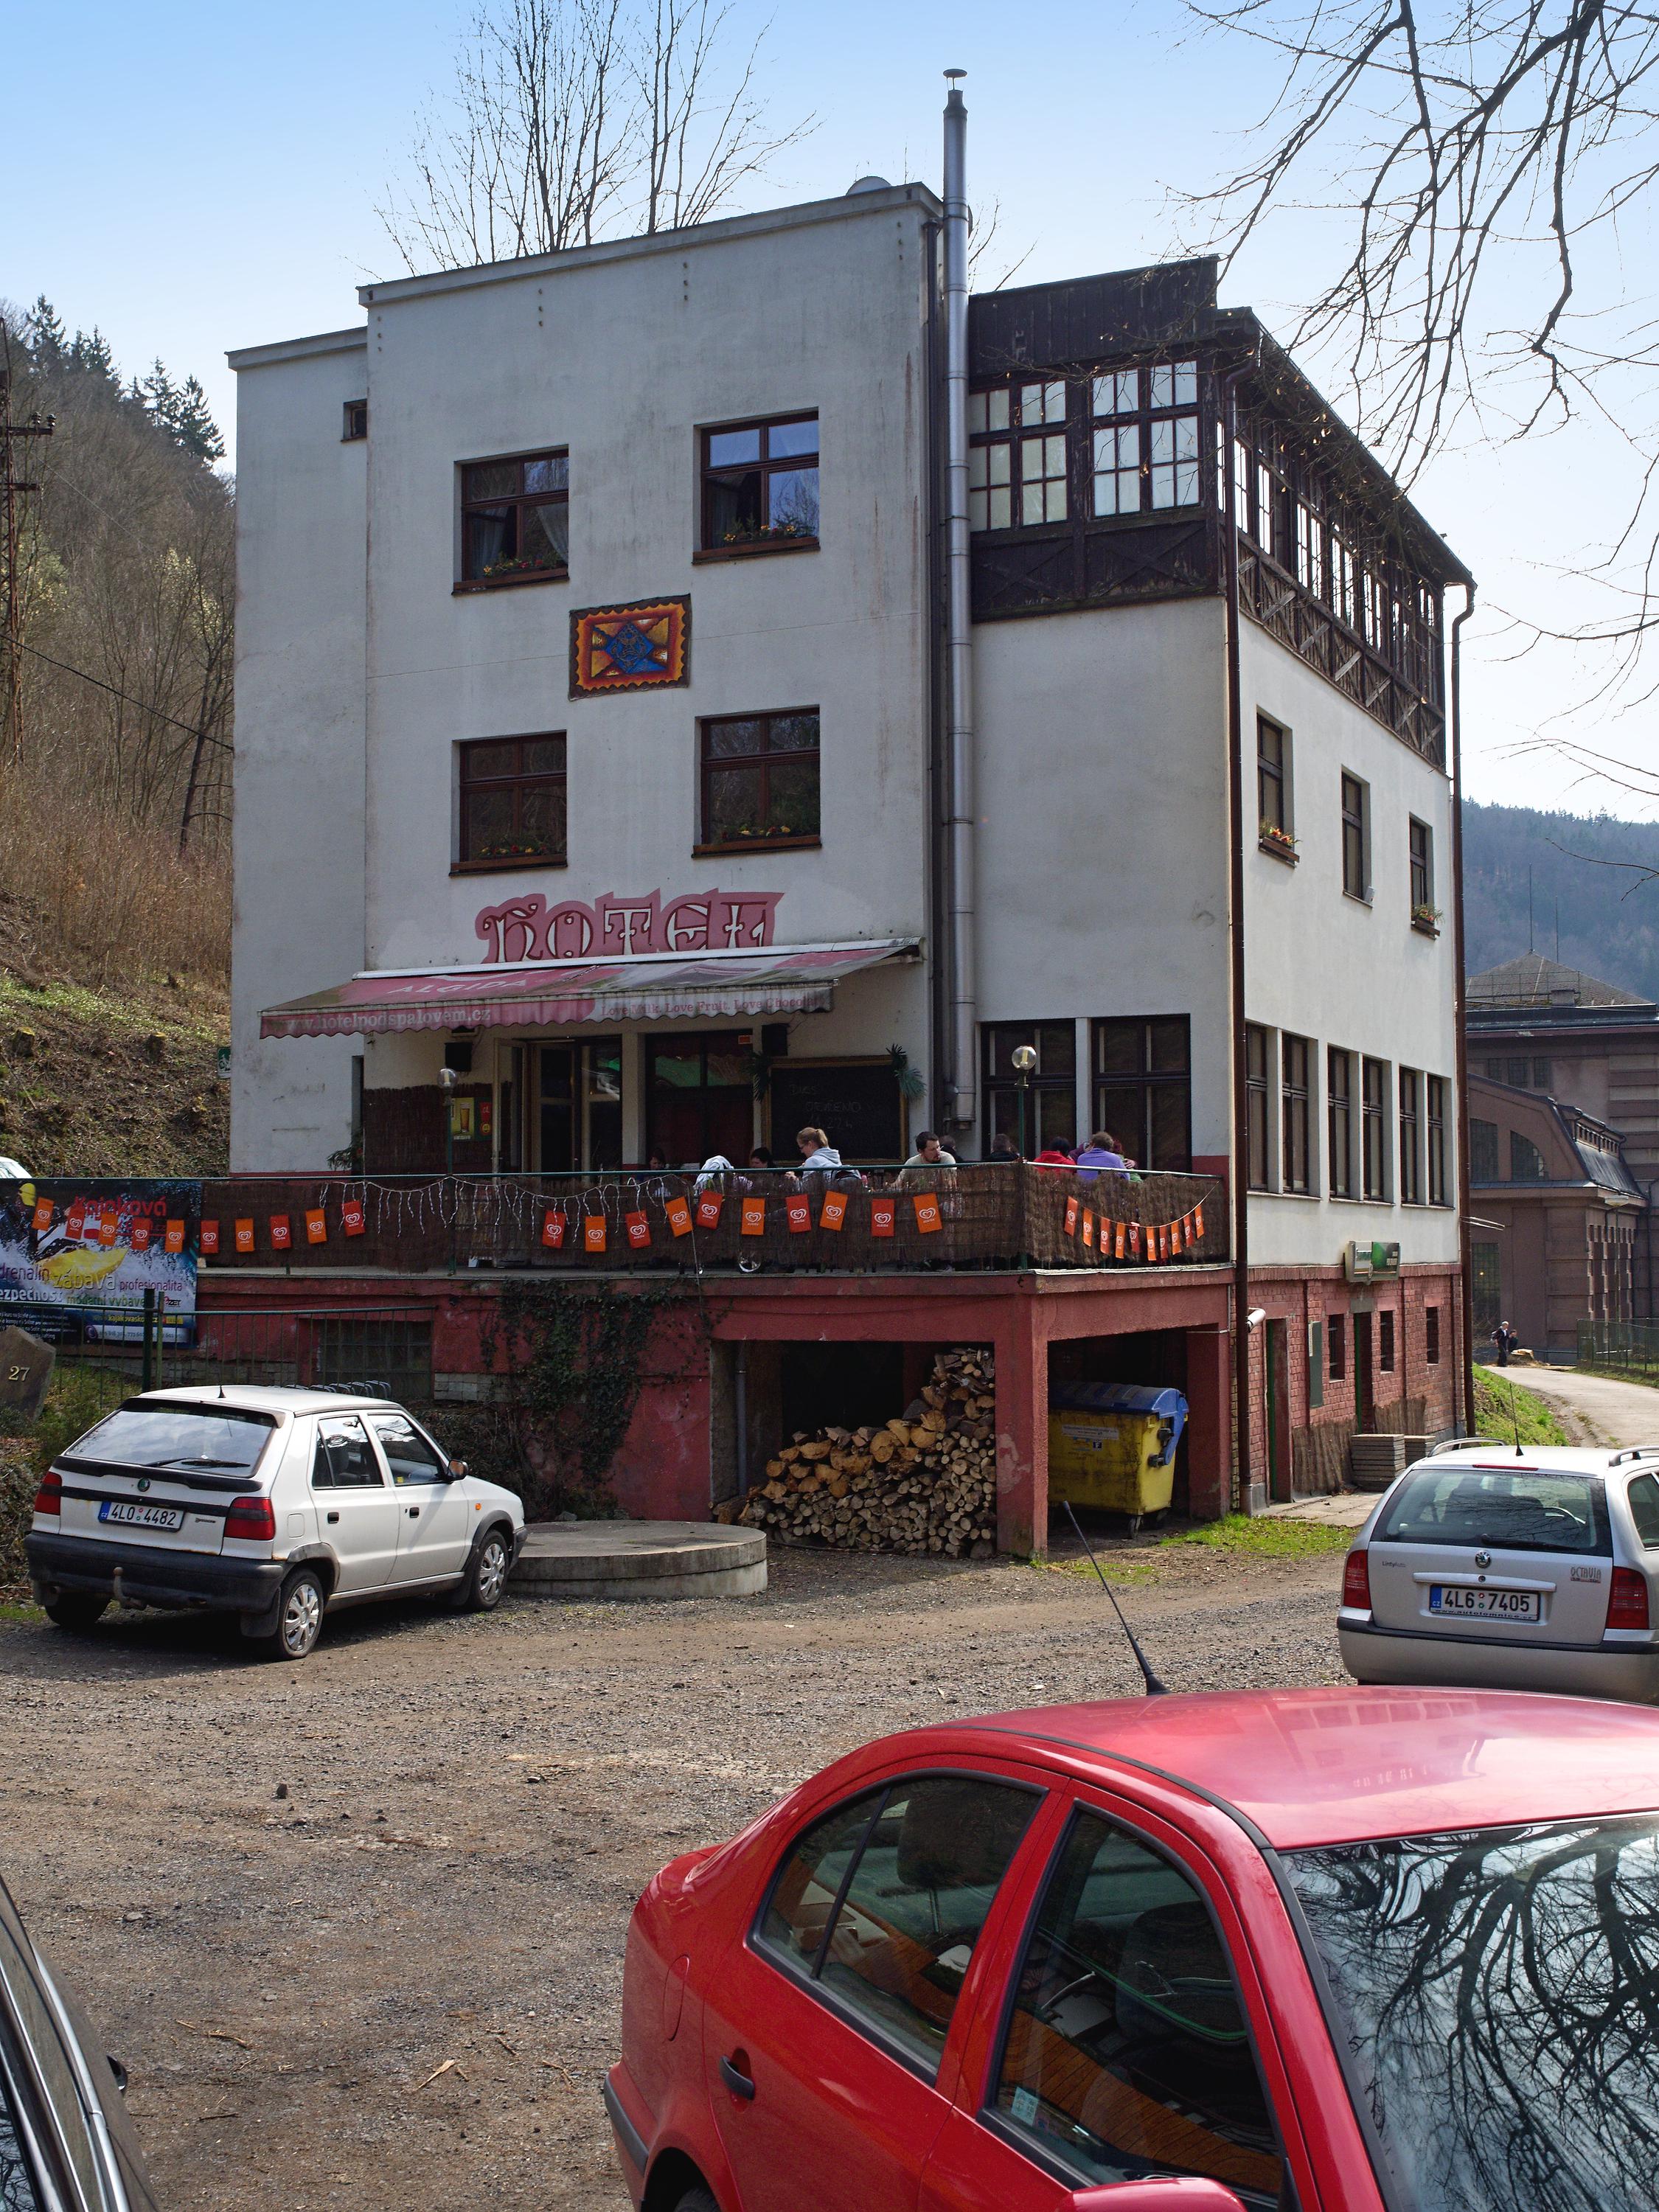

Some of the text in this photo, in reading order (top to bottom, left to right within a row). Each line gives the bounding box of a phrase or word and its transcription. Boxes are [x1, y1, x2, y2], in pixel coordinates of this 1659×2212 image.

[476, 897, 779, 964] HOTEL
[386, 979, 527, 994] ALGIDA
[270, 1007, 491, 1031] ww.hotelpodspalovem.cz
[601, 1005, 628, 1017] Love
[665, 1003, 693, 1013] Love
[734, 999, 762, 1010] Love
[52, 1268, 183, 1292] zábava profesionalita
[9, 1366, 30, 1381] 27
[111, 1504, 136, 1520] 4L0
[143, 1508, 176, 1526] 4482
[1571, 1566, 1601, 1579] OCTAVIA
[1444, 1590, 1475, 1609] 4L6
[1488, 1593, 1530, 1613] 7405
